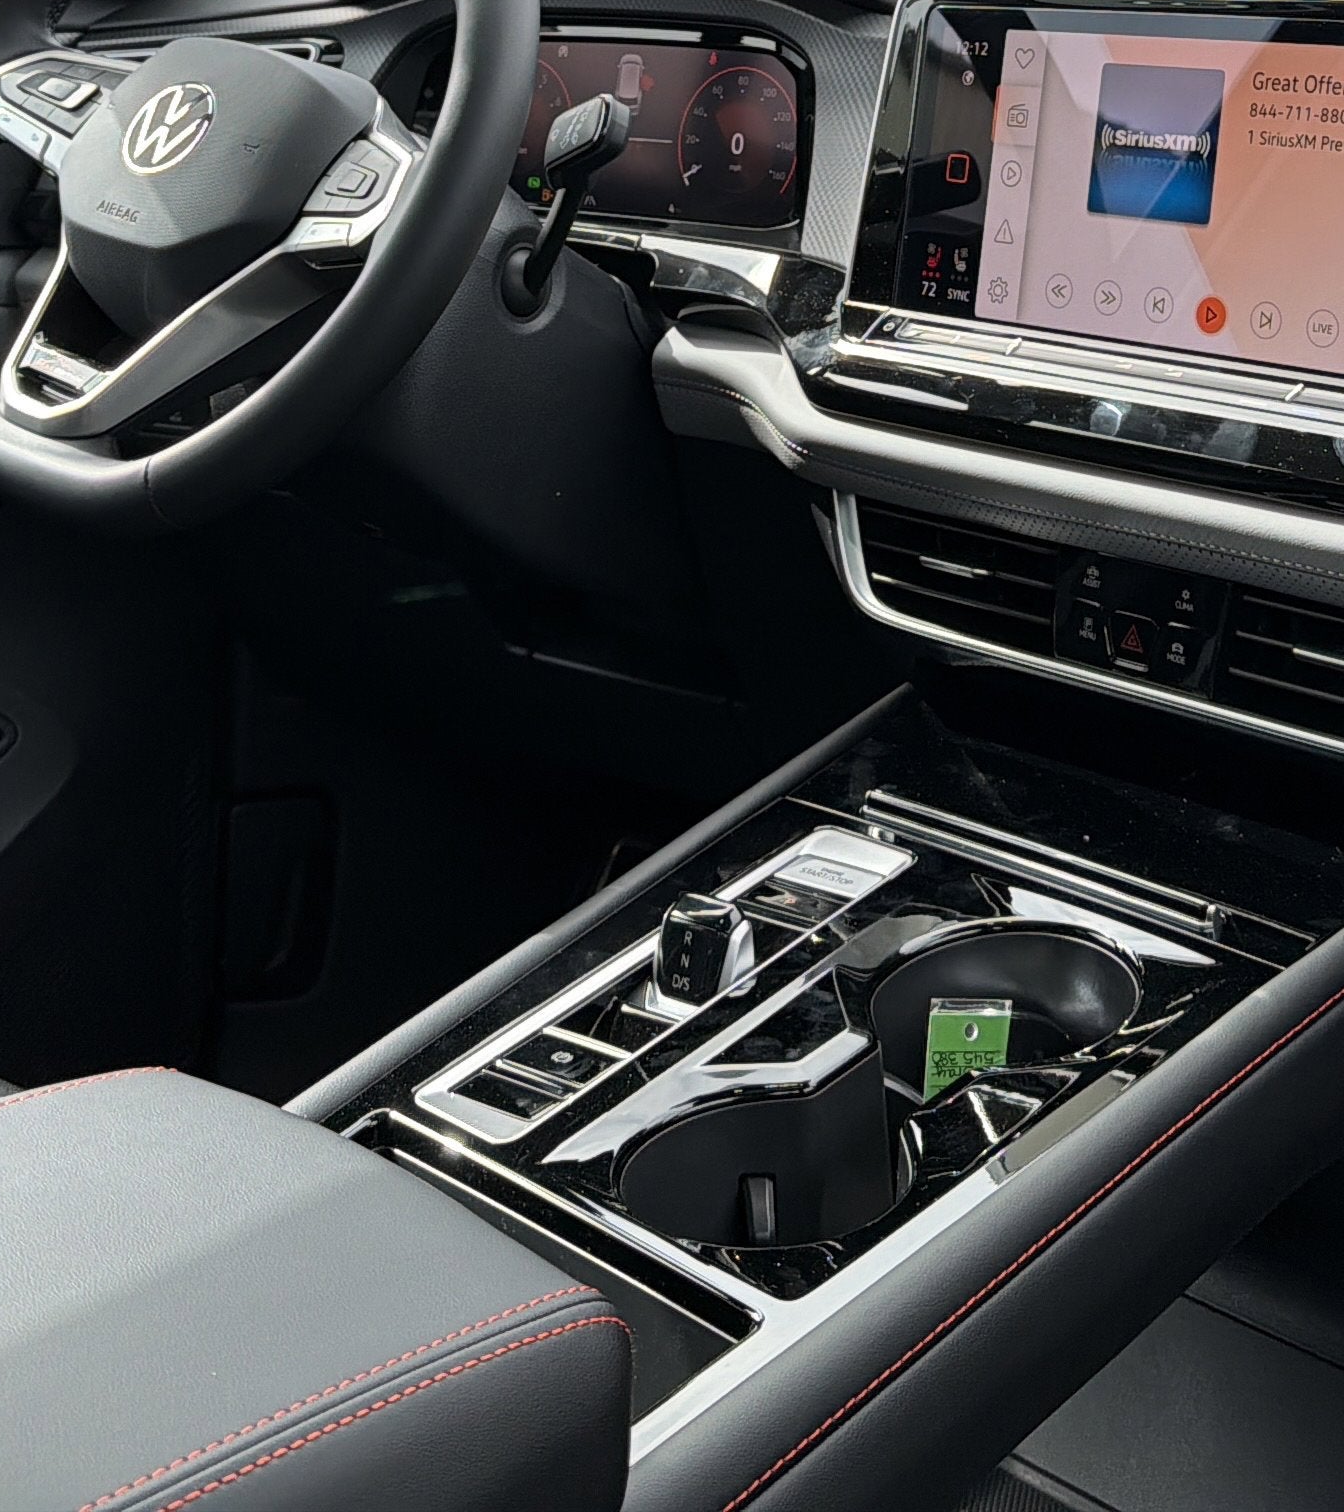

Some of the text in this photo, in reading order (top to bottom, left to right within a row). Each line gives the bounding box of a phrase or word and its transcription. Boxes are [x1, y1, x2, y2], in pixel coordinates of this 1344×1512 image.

[956, 41, 989, 56] 12:12
[1252, 71, 1299, 94] Great
[731, 133, 744, 155] 0
[1248, 129, 1255, 146] 1
[1259, 130, 1317, 151] SiriusXM
[921, 280, 971, 303] 72 SYNC
[1312, 322, 1333, 336] LIVE
[683, 930, 693, 947] R
[680, 953, 690, 969] N
[671, 972, 691, 992] D/S
[962, 1051, 994, 1065] 545
